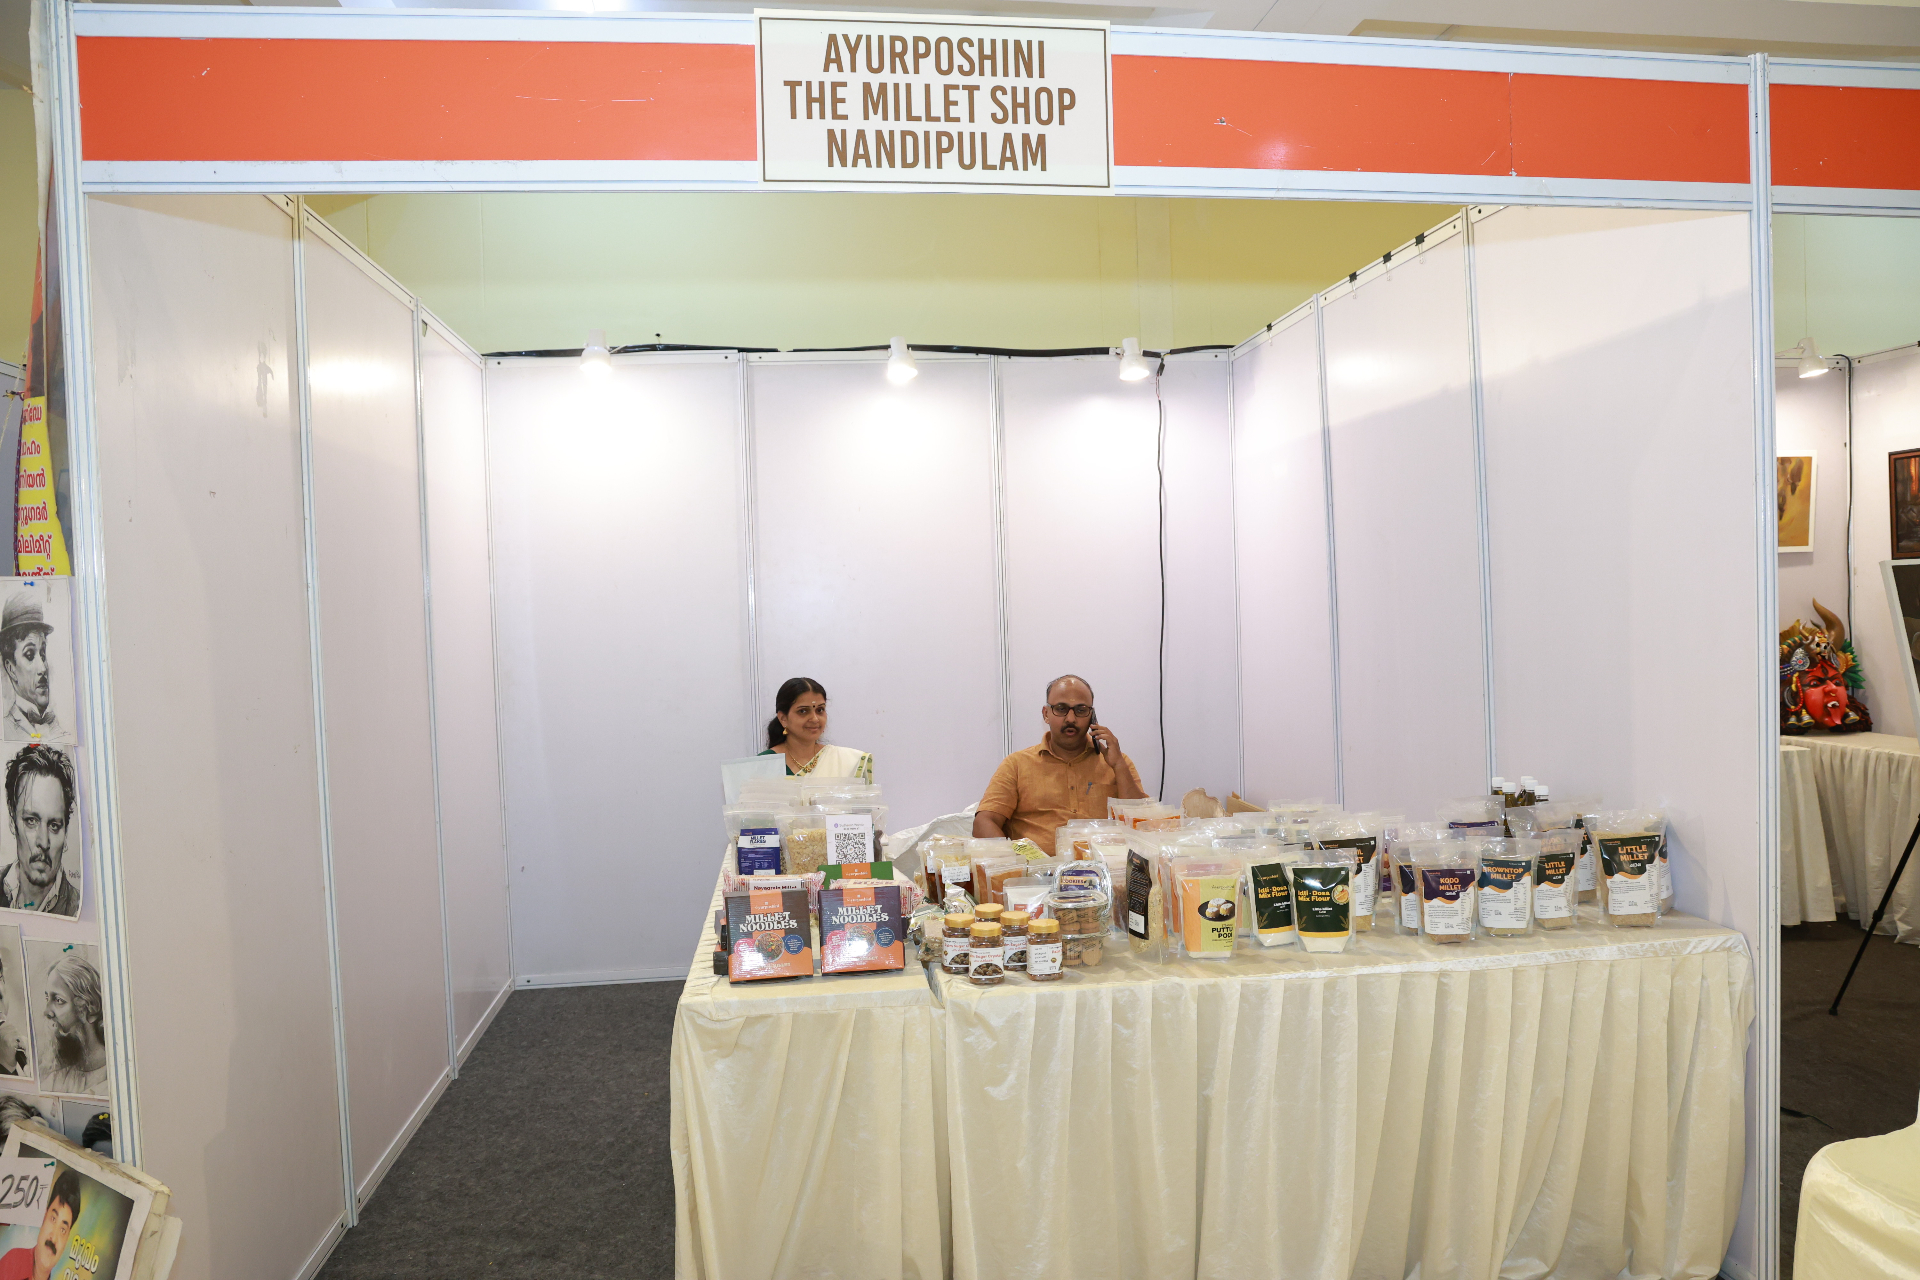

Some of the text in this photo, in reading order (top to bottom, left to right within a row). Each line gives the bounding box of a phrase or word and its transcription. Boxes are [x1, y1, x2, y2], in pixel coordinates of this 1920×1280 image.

[823, 34, 1046, 78] AYURPOSHINI
[783, 80, 1076, 126] THE MILLET SHOP
[826, 128, 1047, 171] NANDIPULAM
[1618, 845, 1648, 853] LITTLE
[1620, 853, 1649, 861] MILLET
[1481, 866, 1524, 874] BROWNTOP
[837, 905, 883, 916] MILLET
[745, 912, 791, 924] MILLET
[832, 912, 889, 925] NOODLES
[739, 919, 798, 932] NOODLES
